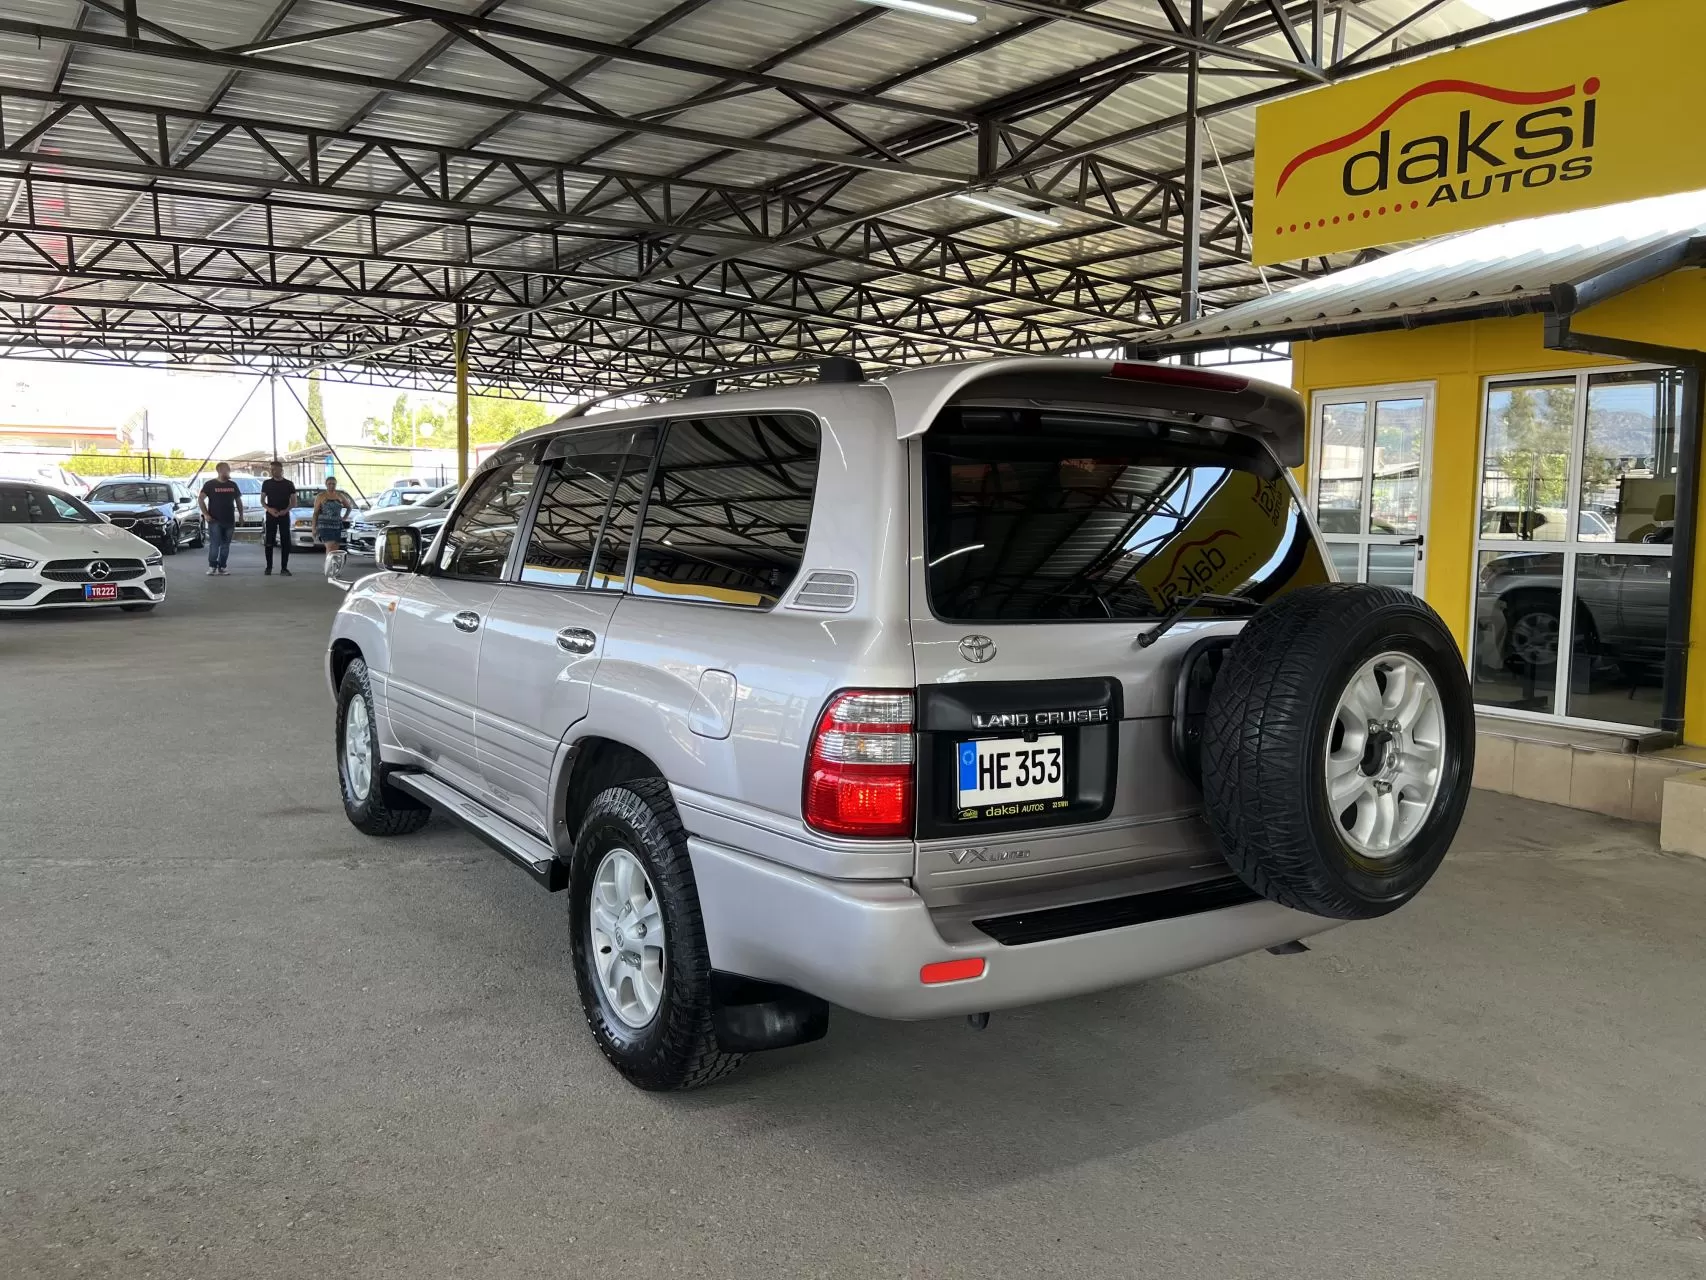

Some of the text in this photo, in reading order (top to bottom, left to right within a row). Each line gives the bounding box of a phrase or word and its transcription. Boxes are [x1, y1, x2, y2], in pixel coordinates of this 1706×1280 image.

[1342, 77, 1600, 196] daksi
[1426, 156, 1593, 207] AUTOS
[92, 587, 115, 596] TR222
[976, 708, 1109, 728] LAND CRUISER
[986, 804, 1019, 817] daksi
[1021, 803, 1044, 813] AUTOS
[948, 847, 988, 865] VX
